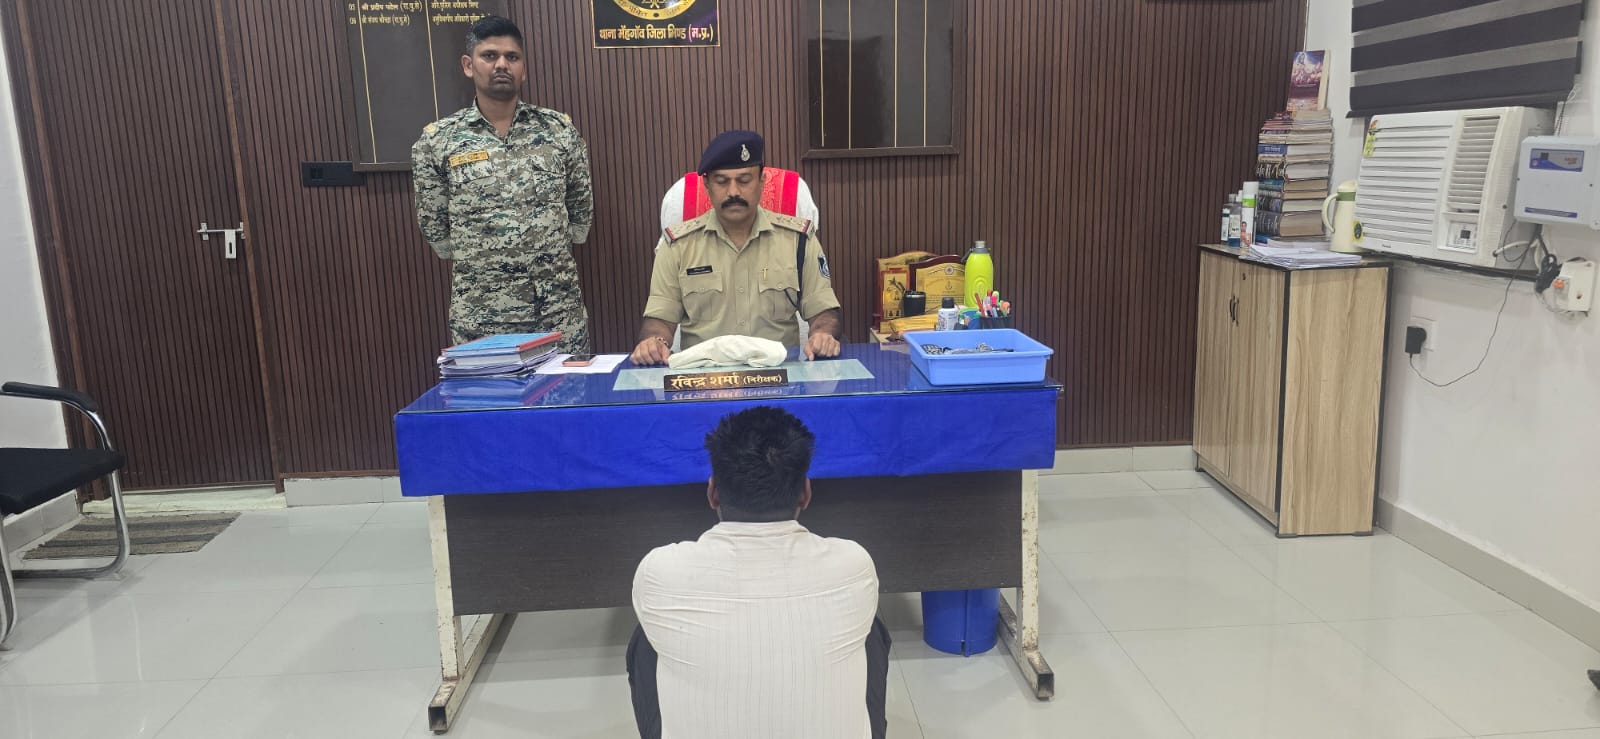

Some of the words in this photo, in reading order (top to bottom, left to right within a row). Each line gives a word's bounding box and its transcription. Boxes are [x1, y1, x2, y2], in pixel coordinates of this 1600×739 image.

[599, 28, 617, 40] थाना
[646, 23, 666, 39] जिला
[667, 23, 687, 39] भिण्ड
[671, 375, 707, 389] रविन्द्र
[710, 372, 740, 385] शर्मा
[743, 374, 783, 385] (निरीक्षक)
